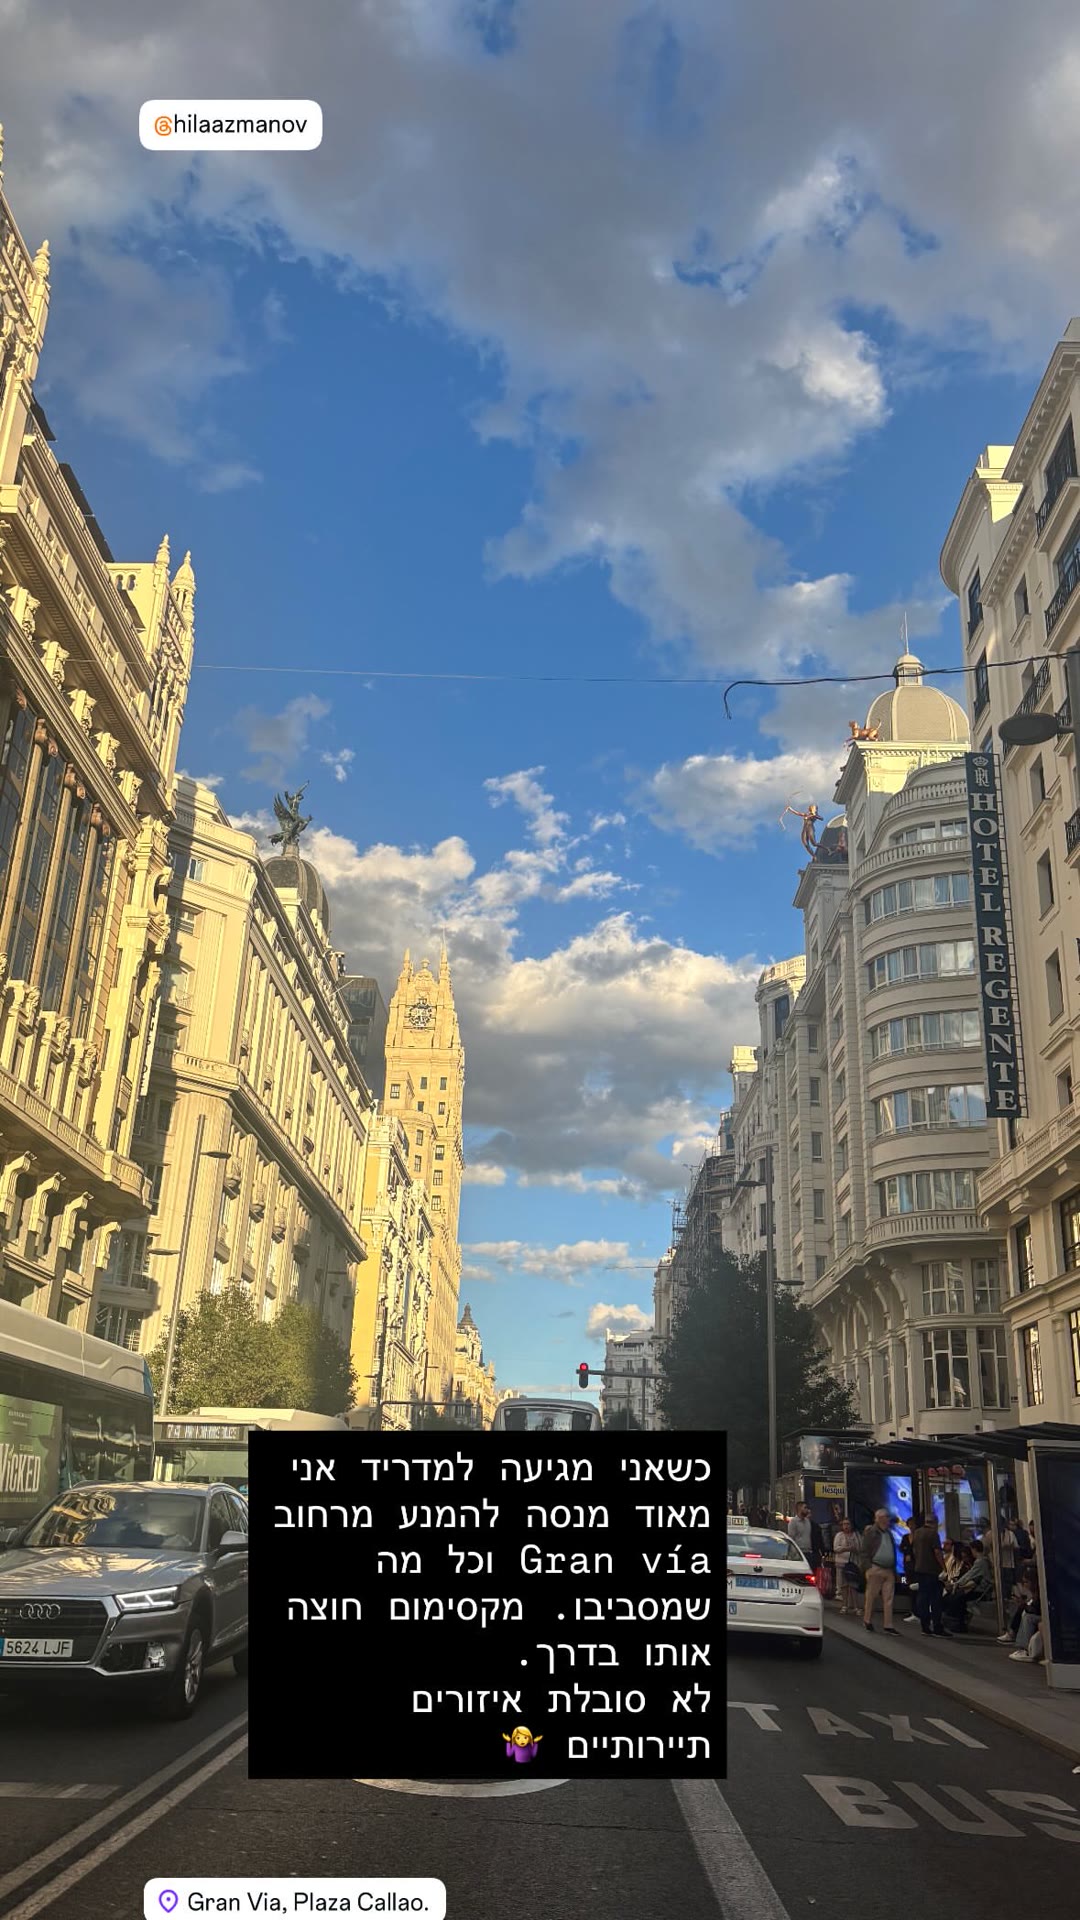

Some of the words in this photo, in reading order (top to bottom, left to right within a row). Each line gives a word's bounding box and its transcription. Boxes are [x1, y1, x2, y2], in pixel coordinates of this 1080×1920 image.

[970, 793, 1000, 912] HOTEL
[981, 926, 1018, 1112] REGENTE
[6, 1641, 39, 1654] 5624
[43, 1641, 70, 1655] LJF
[727, 1701, 990, 1749] TAXI
[802, 1774, 1080, 1843] BUS
